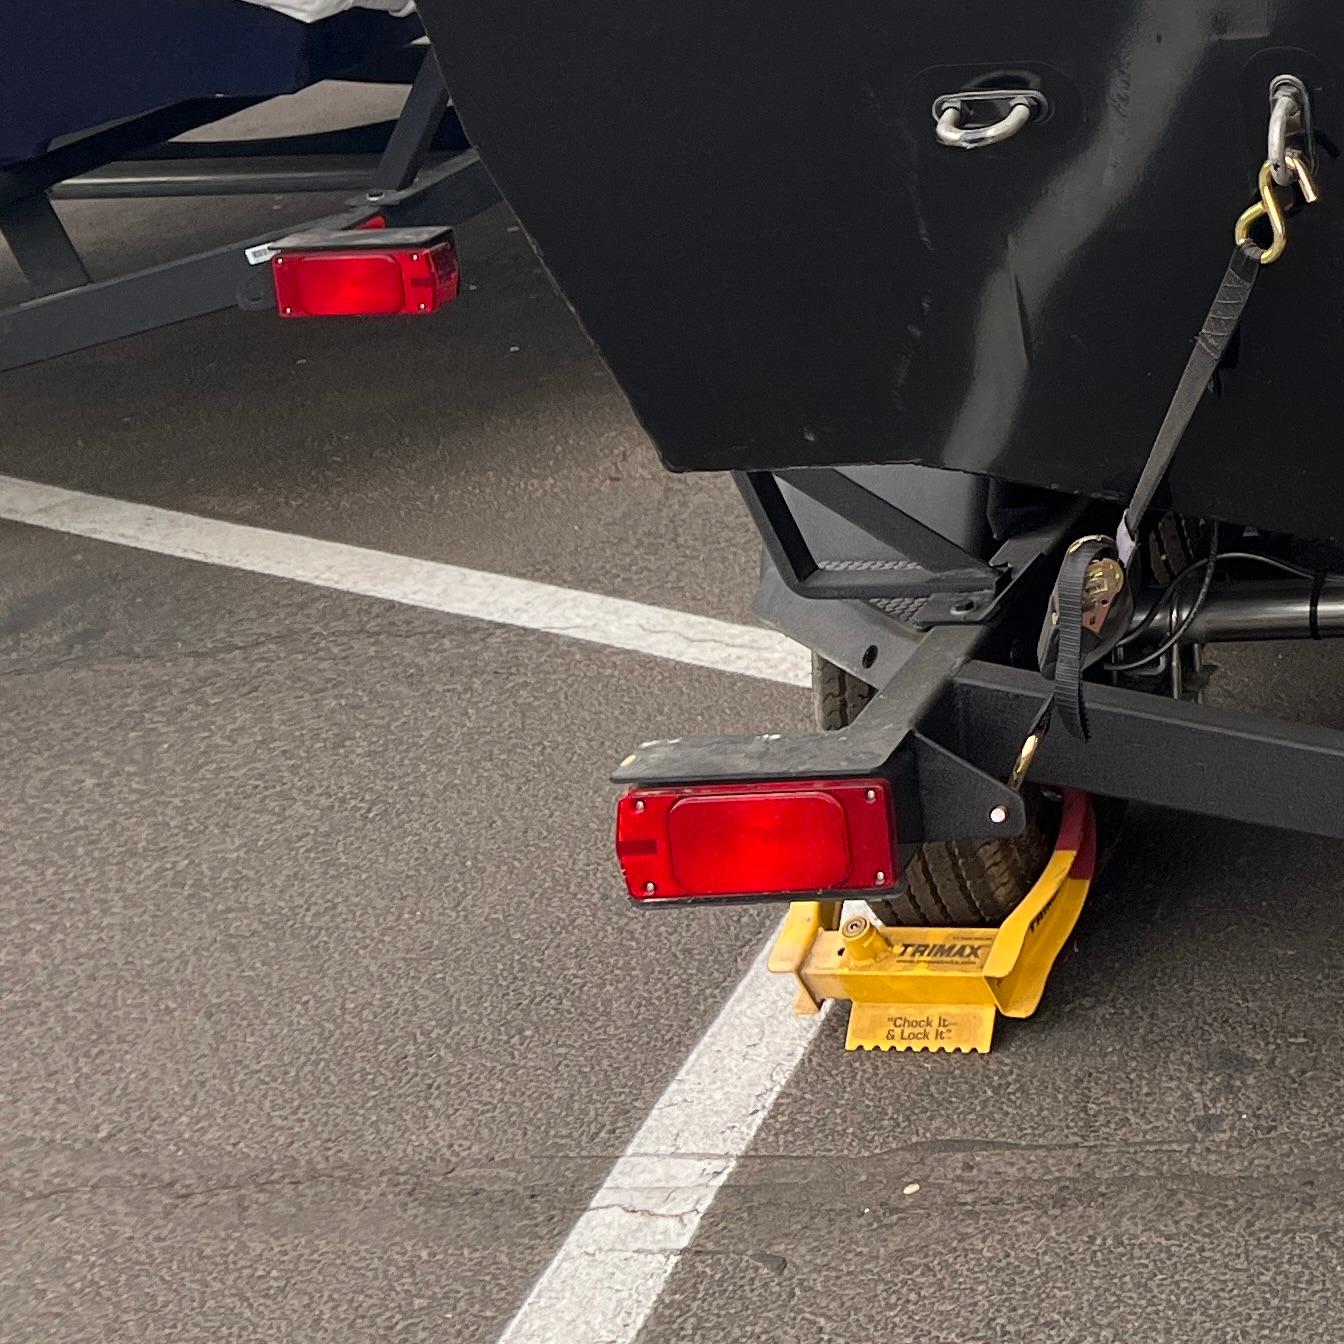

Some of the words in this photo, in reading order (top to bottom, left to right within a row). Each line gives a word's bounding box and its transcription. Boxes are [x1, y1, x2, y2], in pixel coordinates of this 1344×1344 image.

[899, 943, 983, 958] TRIMAX
[885, 1028, 896, 1041] &
[900, 1027, 931, 1041] Lock
